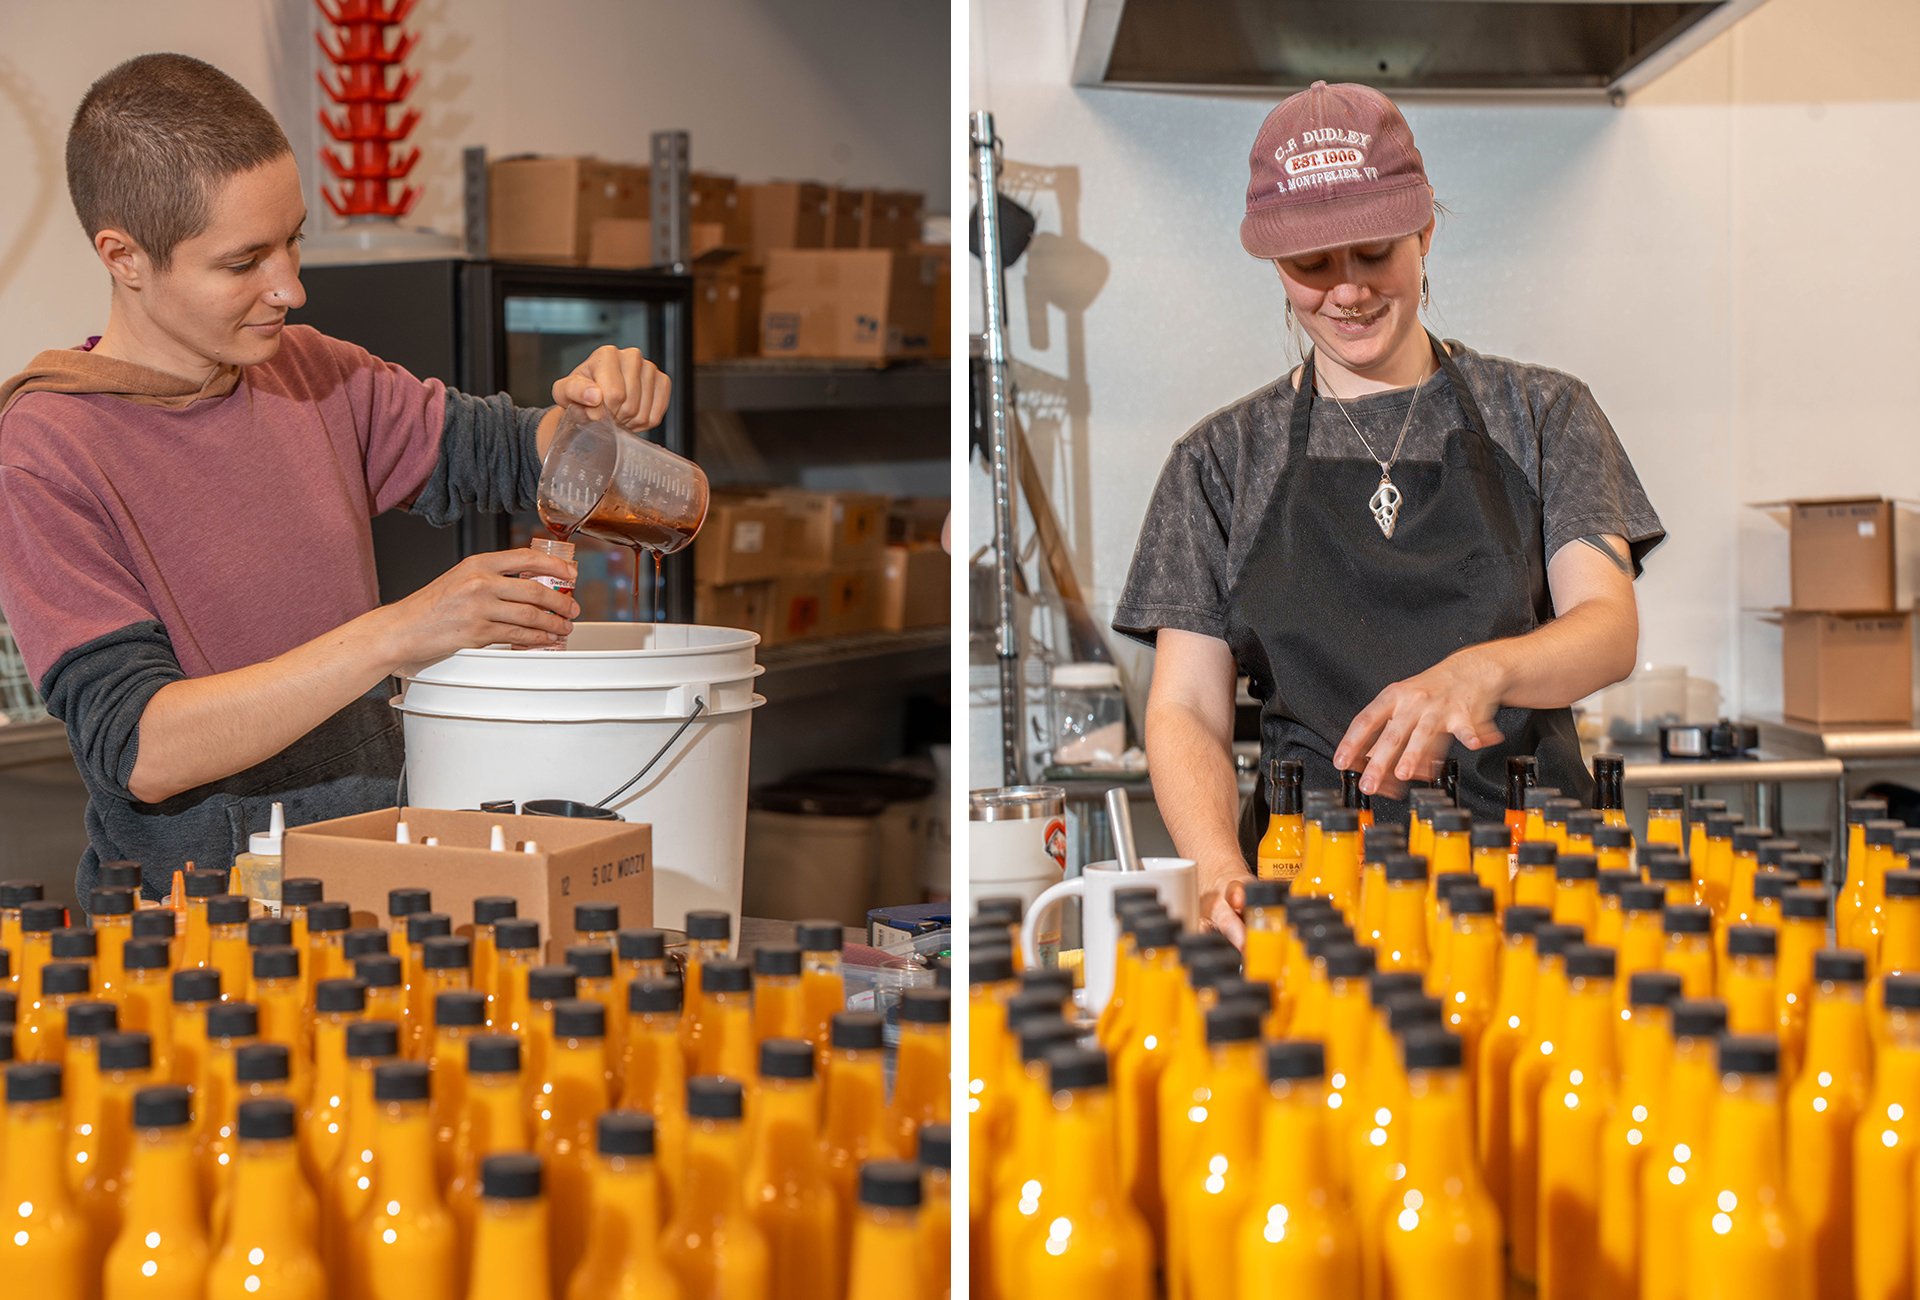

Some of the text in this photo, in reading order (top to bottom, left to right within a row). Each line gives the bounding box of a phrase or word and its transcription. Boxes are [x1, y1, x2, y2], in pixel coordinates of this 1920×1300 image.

[1302, 128, 1371, 147] DUDLEY
[1291, 150, 1357, 171] EST. 1906
[592, 866, 599, 887] 5
[601, 862, 613, 884] OZ
[618, 853, 645, 878] WOOZY
